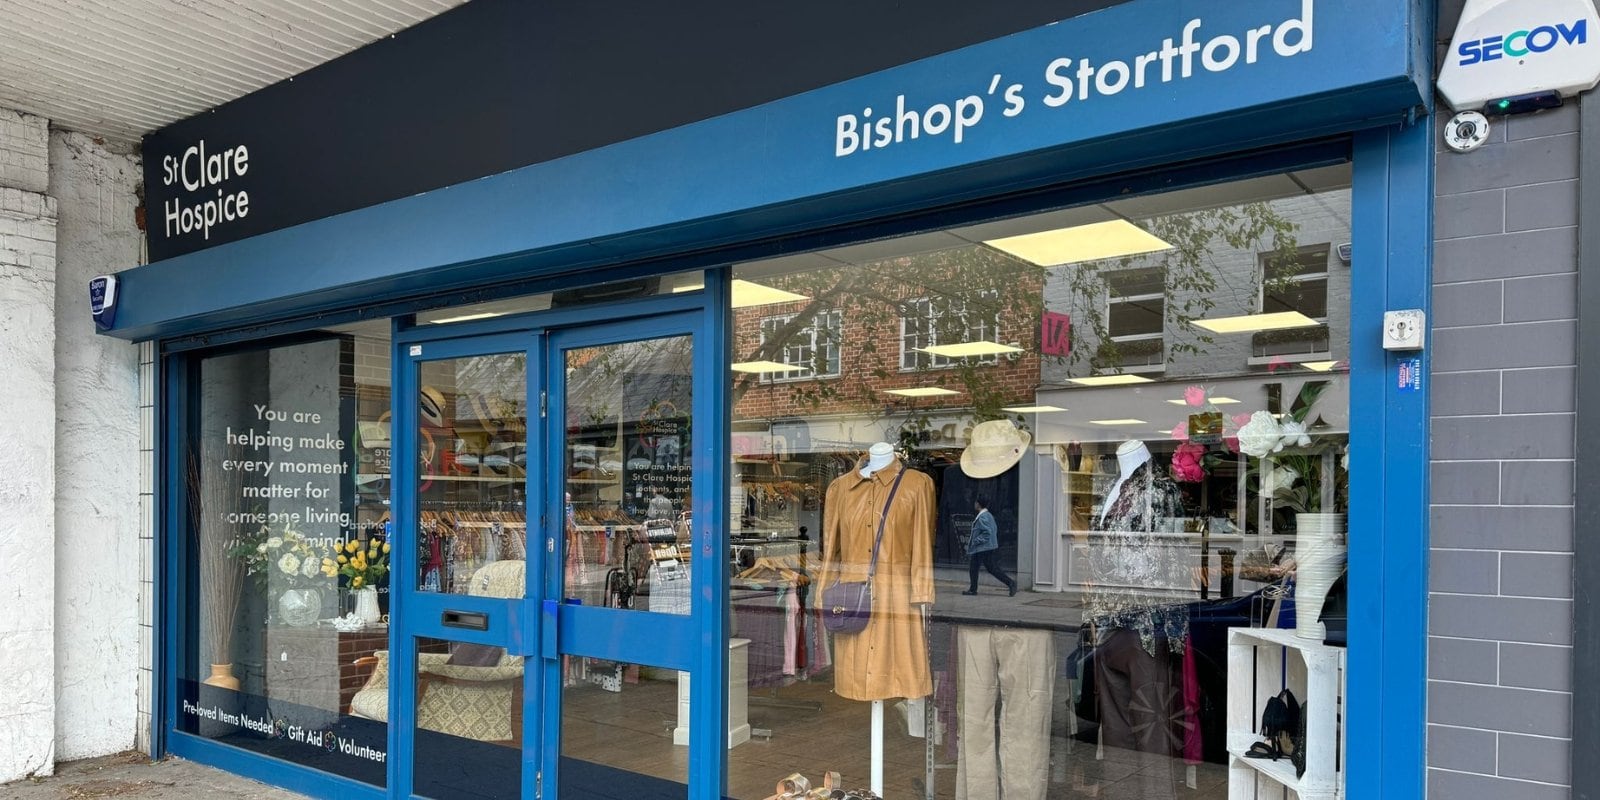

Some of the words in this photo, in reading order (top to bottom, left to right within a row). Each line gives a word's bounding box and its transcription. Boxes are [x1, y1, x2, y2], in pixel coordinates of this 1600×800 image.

[1458, 19, 1587, 66] SECOM
[835, 73, 1025, 157] Bishop's
[1042, 0, 1314, 108] Stortford
[163, 155, 179, 186] St
[181, 139, 249, 192] Clare
[165, 189, 249, 240] Hospice
[254, 404, 287, 422] You
[293, 411, 321, 424] are
[227, 427, 294, 452] helping
[299, 433, 345, 450] make
[222, 458, 274, 476] every
[280, 459, 348, 475] moment
[633, 462, 650, 470] You
[666, 462, 692, 473] helpin
[632, 473, 641, 481] St
[643, 473, 664, 481] Clare
[666, 474, 693, 484] Hospic
[674, 485, 690, 493] and
[243, 484, 301, 498] matter
[306, 482, 330, 499] for
[306, 506, 350, 527] living
[183, 699, 217, 720] Pre-loved
[218, 709, 239, 726] Items
[240, 715, 274, 735] Needed
[288, 725, 305, 744] Gift
[306, 730, 322, 747] Aid
[338, 738, 386, 763] Volunteer
